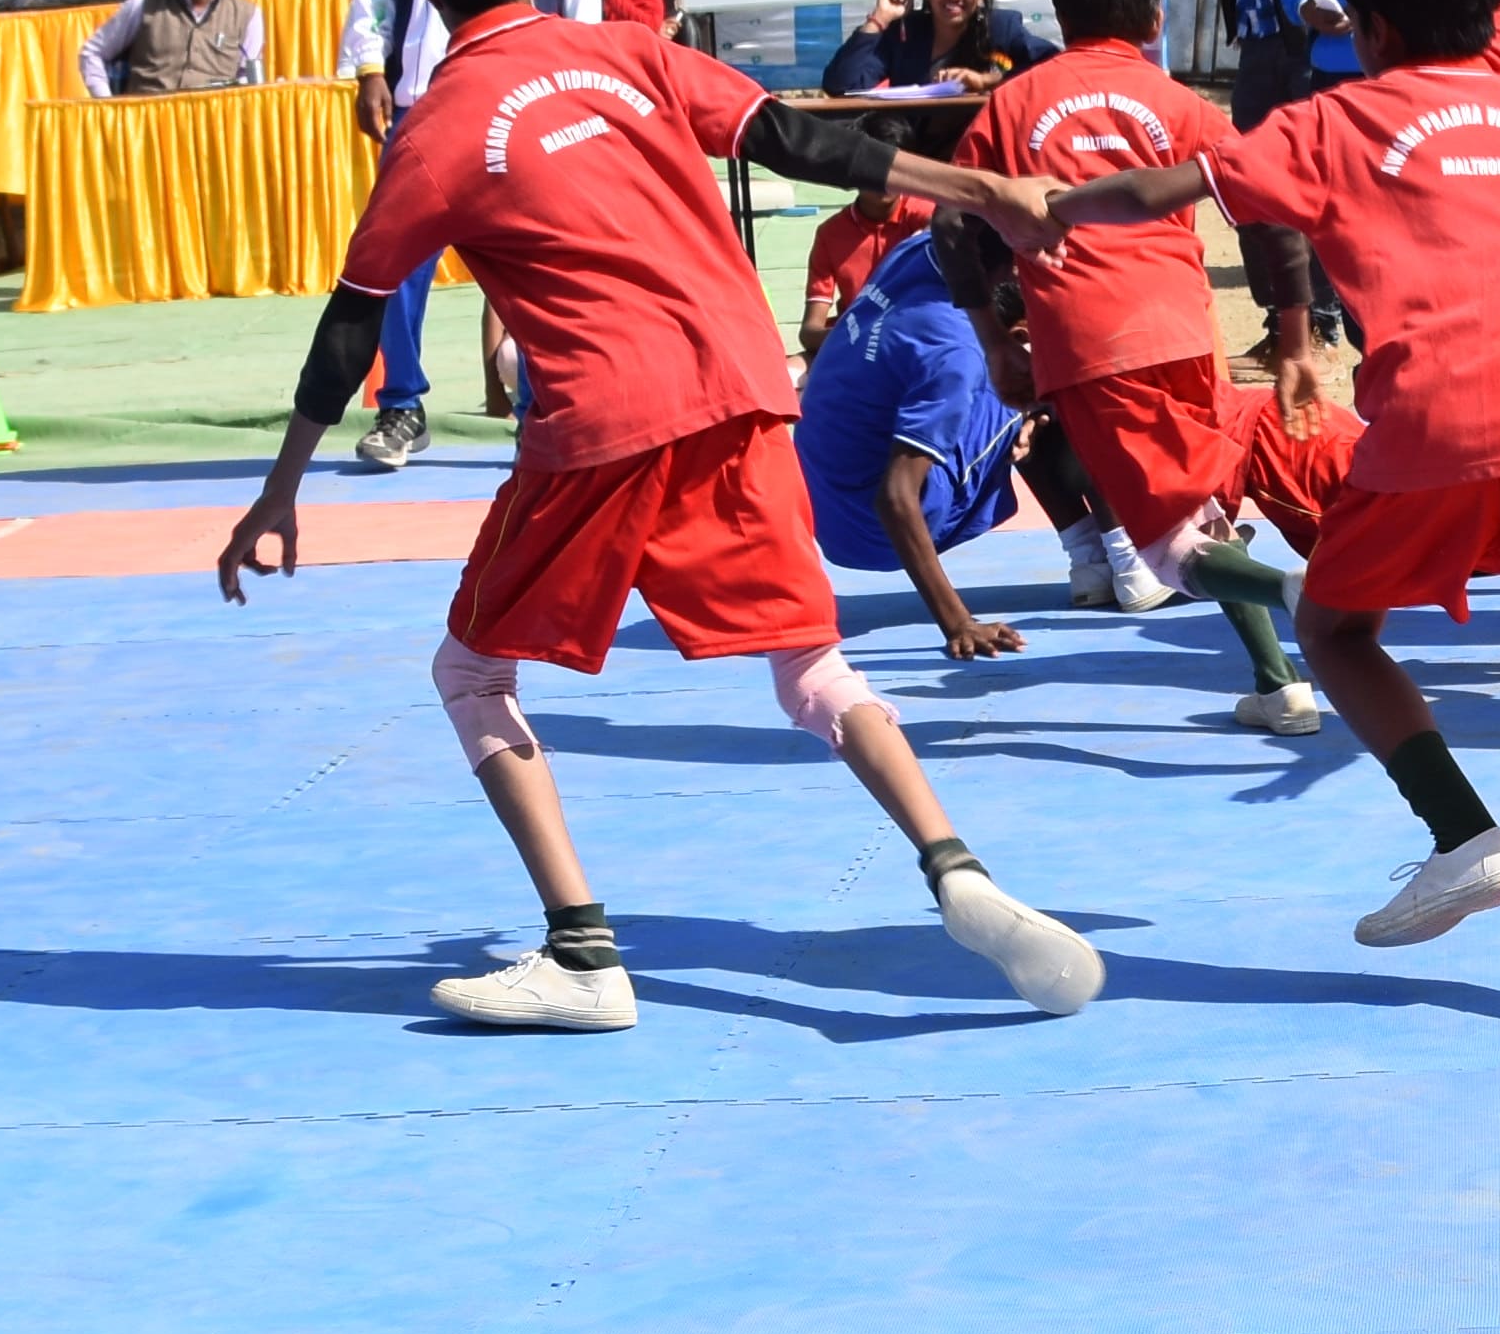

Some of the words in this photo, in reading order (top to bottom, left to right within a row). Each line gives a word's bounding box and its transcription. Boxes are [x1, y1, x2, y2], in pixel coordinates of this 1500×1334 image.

[498, 75, 557, 119] PRABHA
[1028, 106, 1062, 151] AWADH
[1056, 91, 1107, 119] PRABHA
[484, 115, 514, 173] AWADH
[1380, 123, 1426, 178] AWADH
[1416, 102, 1484, 137] PRABHA
